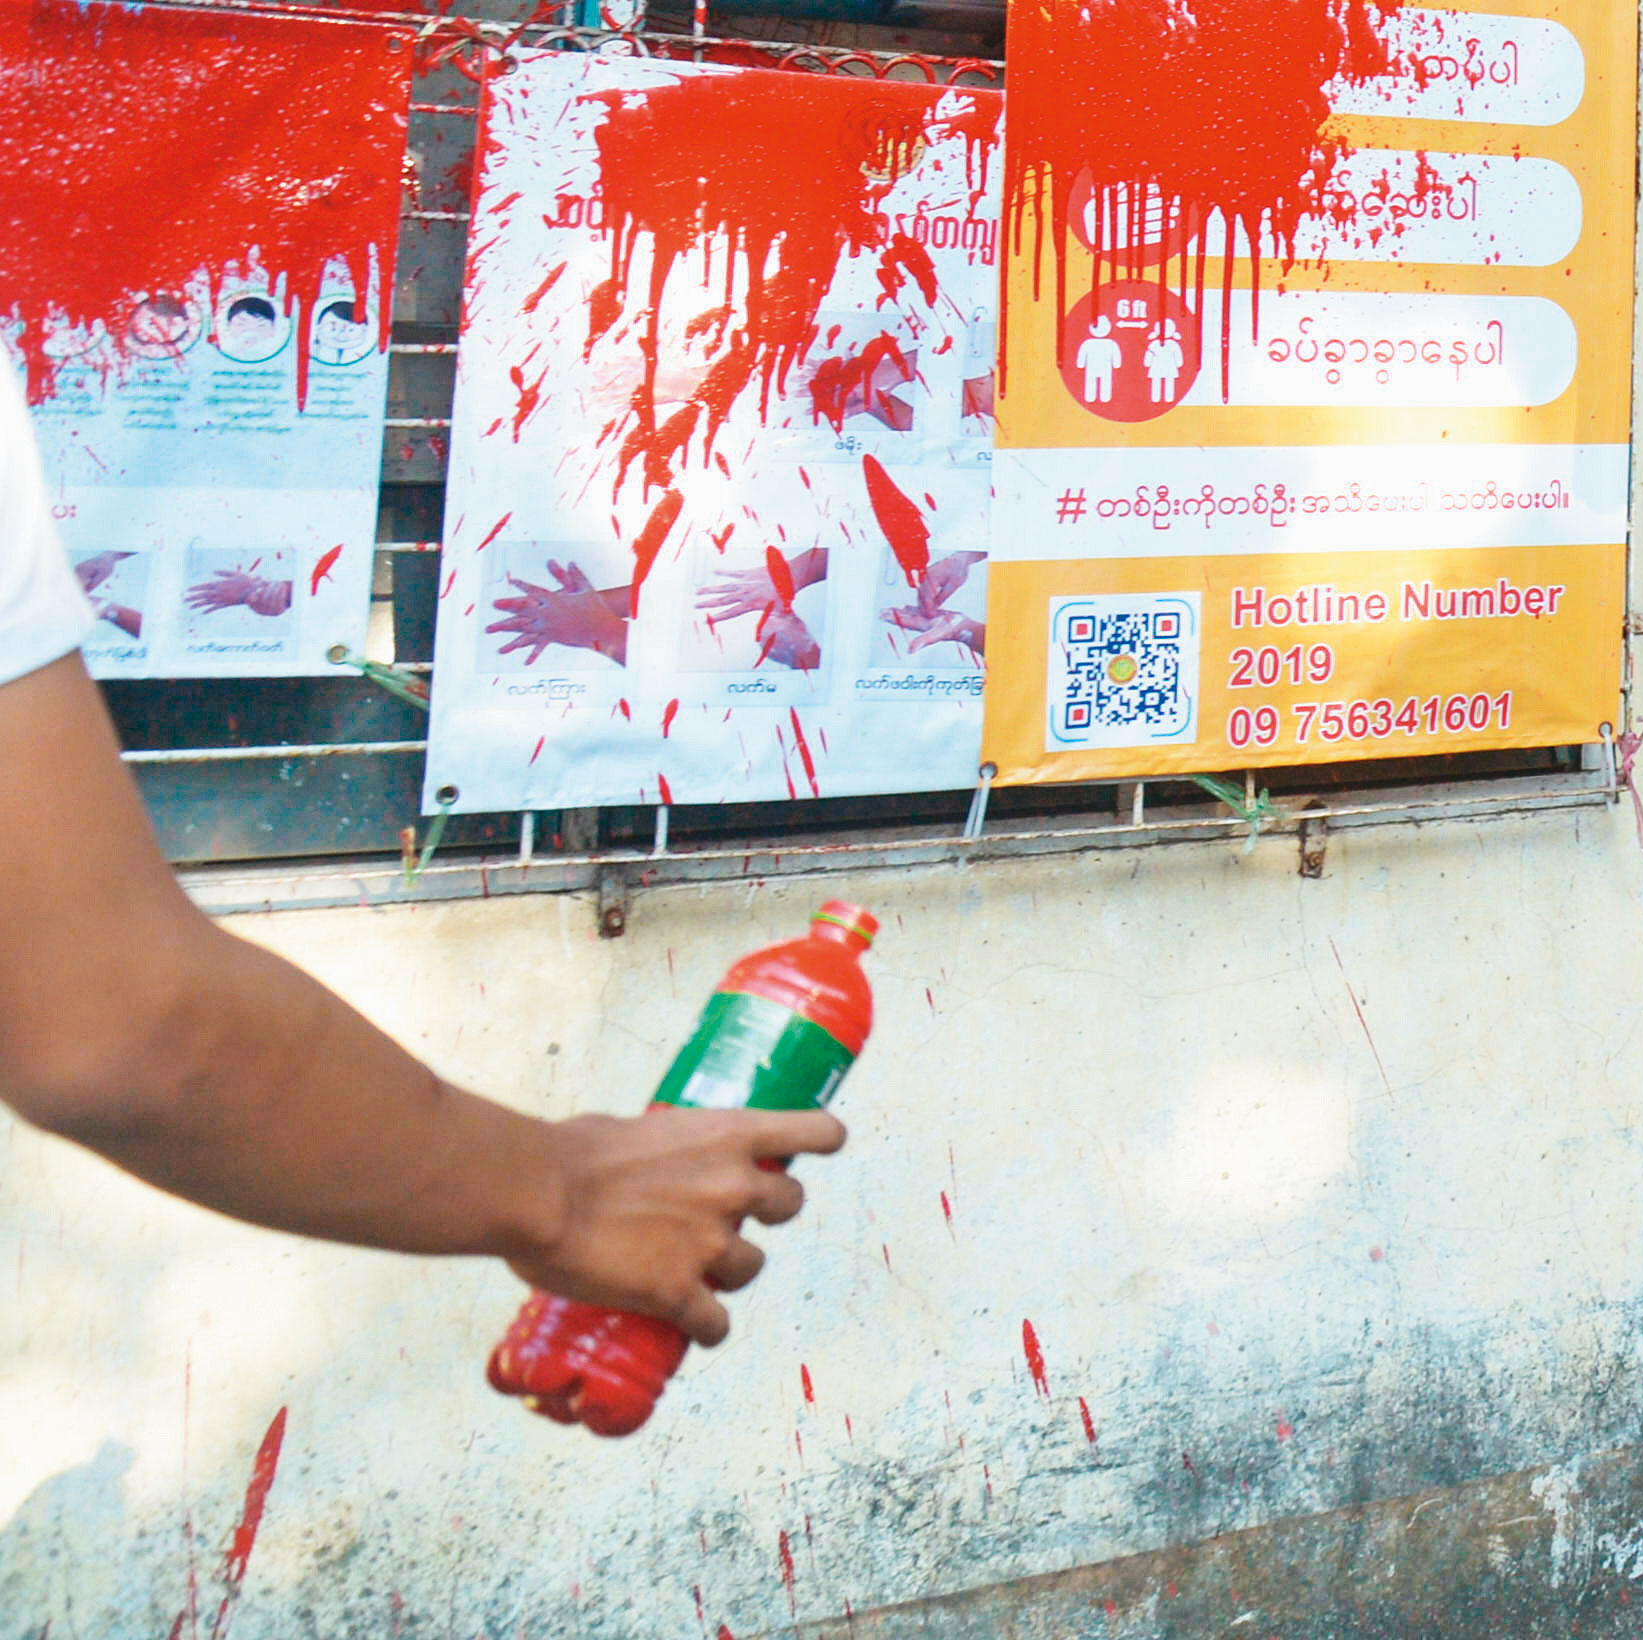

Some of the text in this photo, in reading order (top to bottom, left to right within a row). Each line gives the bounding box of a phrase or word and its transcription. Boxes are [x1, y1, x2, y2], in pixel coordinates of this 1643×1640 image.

[1231, 580, 1565, 628] Hotline Number
[1230, 644, 1334, 690] 2019
[1229, 692, 1513, 748] 09 756341601
